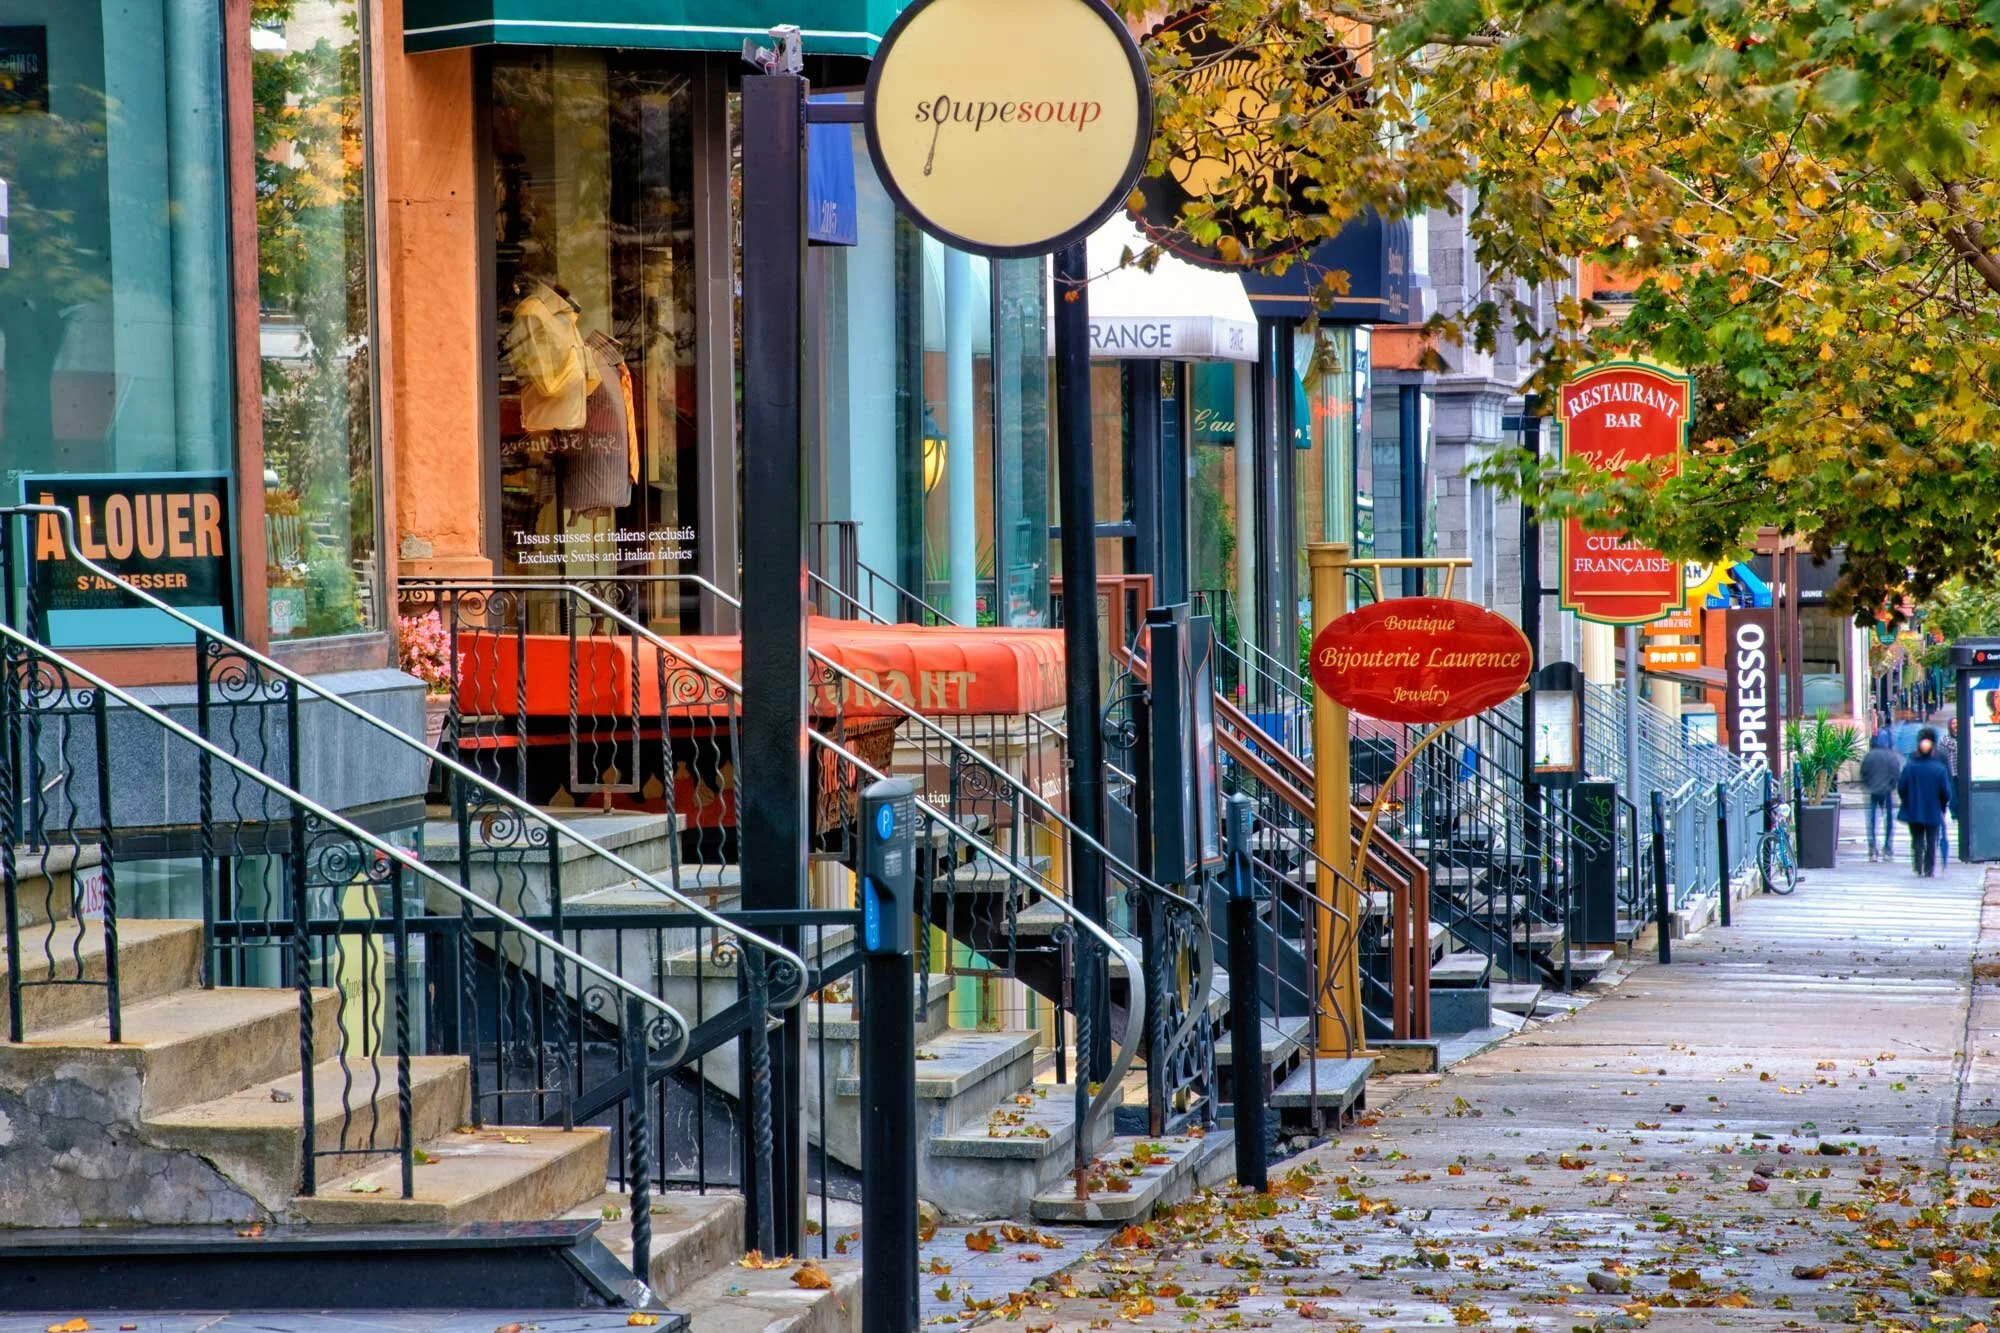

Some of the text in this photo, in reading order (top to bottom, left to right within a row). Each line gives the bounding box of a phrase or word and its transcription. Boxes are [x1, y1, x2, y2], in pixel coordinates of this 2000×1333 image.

[915, 94, 1102, 132] soupesoup
[1568, 382, 1679, 418] RESTAURANT
[1605, 412, 1642, 428] BAR
[78, 493, 224, 560] LOUER
[513, 525, 695, 545] Tissus suisses et italiens exclusifs
[518, 546, 692, 564] Exclusive Swiss and italian fabrics
[1574, 558, 1671, 576] FRANÇAISE
[1384, 615, 1456, 636] Boutique
[1319, 646, 1521, 675] Bijouterie Laurence
[1390, 684, 1450, 707] Jewelry
